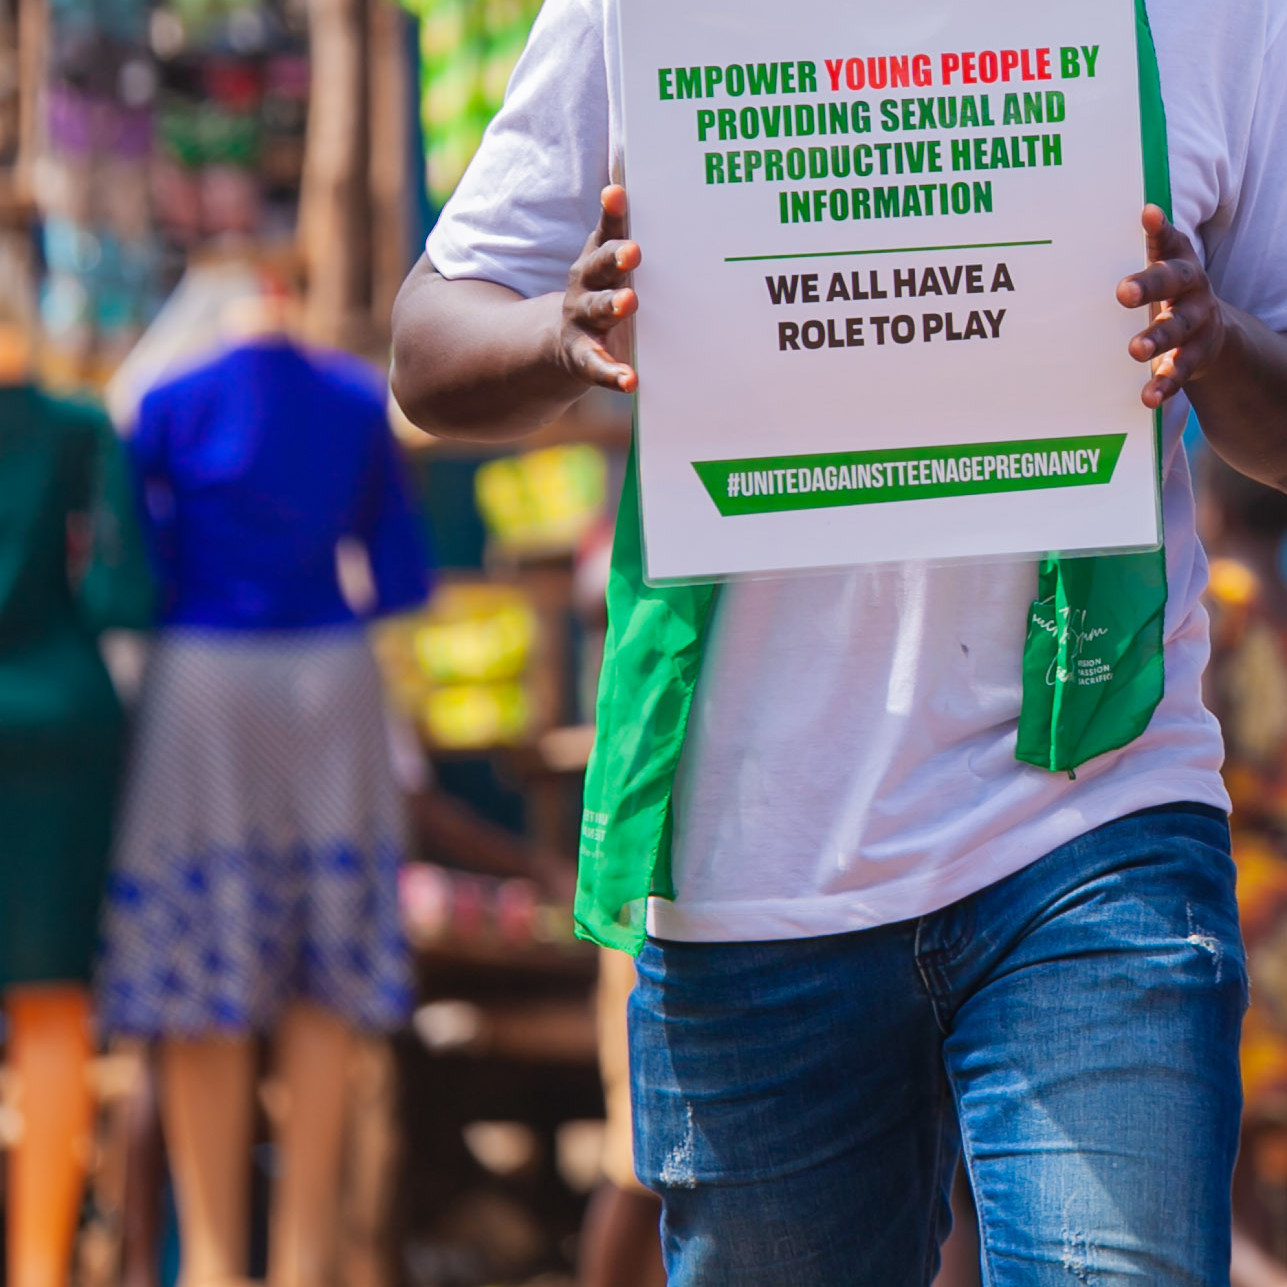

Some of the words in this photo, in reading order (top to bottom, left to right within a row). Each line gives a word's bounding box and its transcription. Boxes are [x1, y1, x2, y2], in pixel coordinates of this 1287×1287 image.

[658, 60, 818, 100] EMPOWER
[824, 54, 933, 91] YOUNG
[941, 47, 1052, 85] PEOPLE
[1060, 45, 1100, 79] BY
[697, 100, 872, 142] PROVIDING
[880, 94, 995, 132] SEXUAL
[1003, 91, 1066, 125] AND
[704, 140, 943, 185] REPRODUCTIVE
[951, 133, 1063, 171] HEALTH
[779, 181, 993, 224] INFORMATION
[765, 273, 821, 305] WE
[825, 270, 889, 302] ALL
[893, 266, 984, 299] HAVE
[989, 263, 1015, 293] A
[777, 317, 865, 351] ROLE
[870, 314, 916, 346] TO
[922, 309, 1007, 343] PLAY
[727, 448, 1101, 498] #UNITEDAGAINSTTEENAGEPREGNANCY
